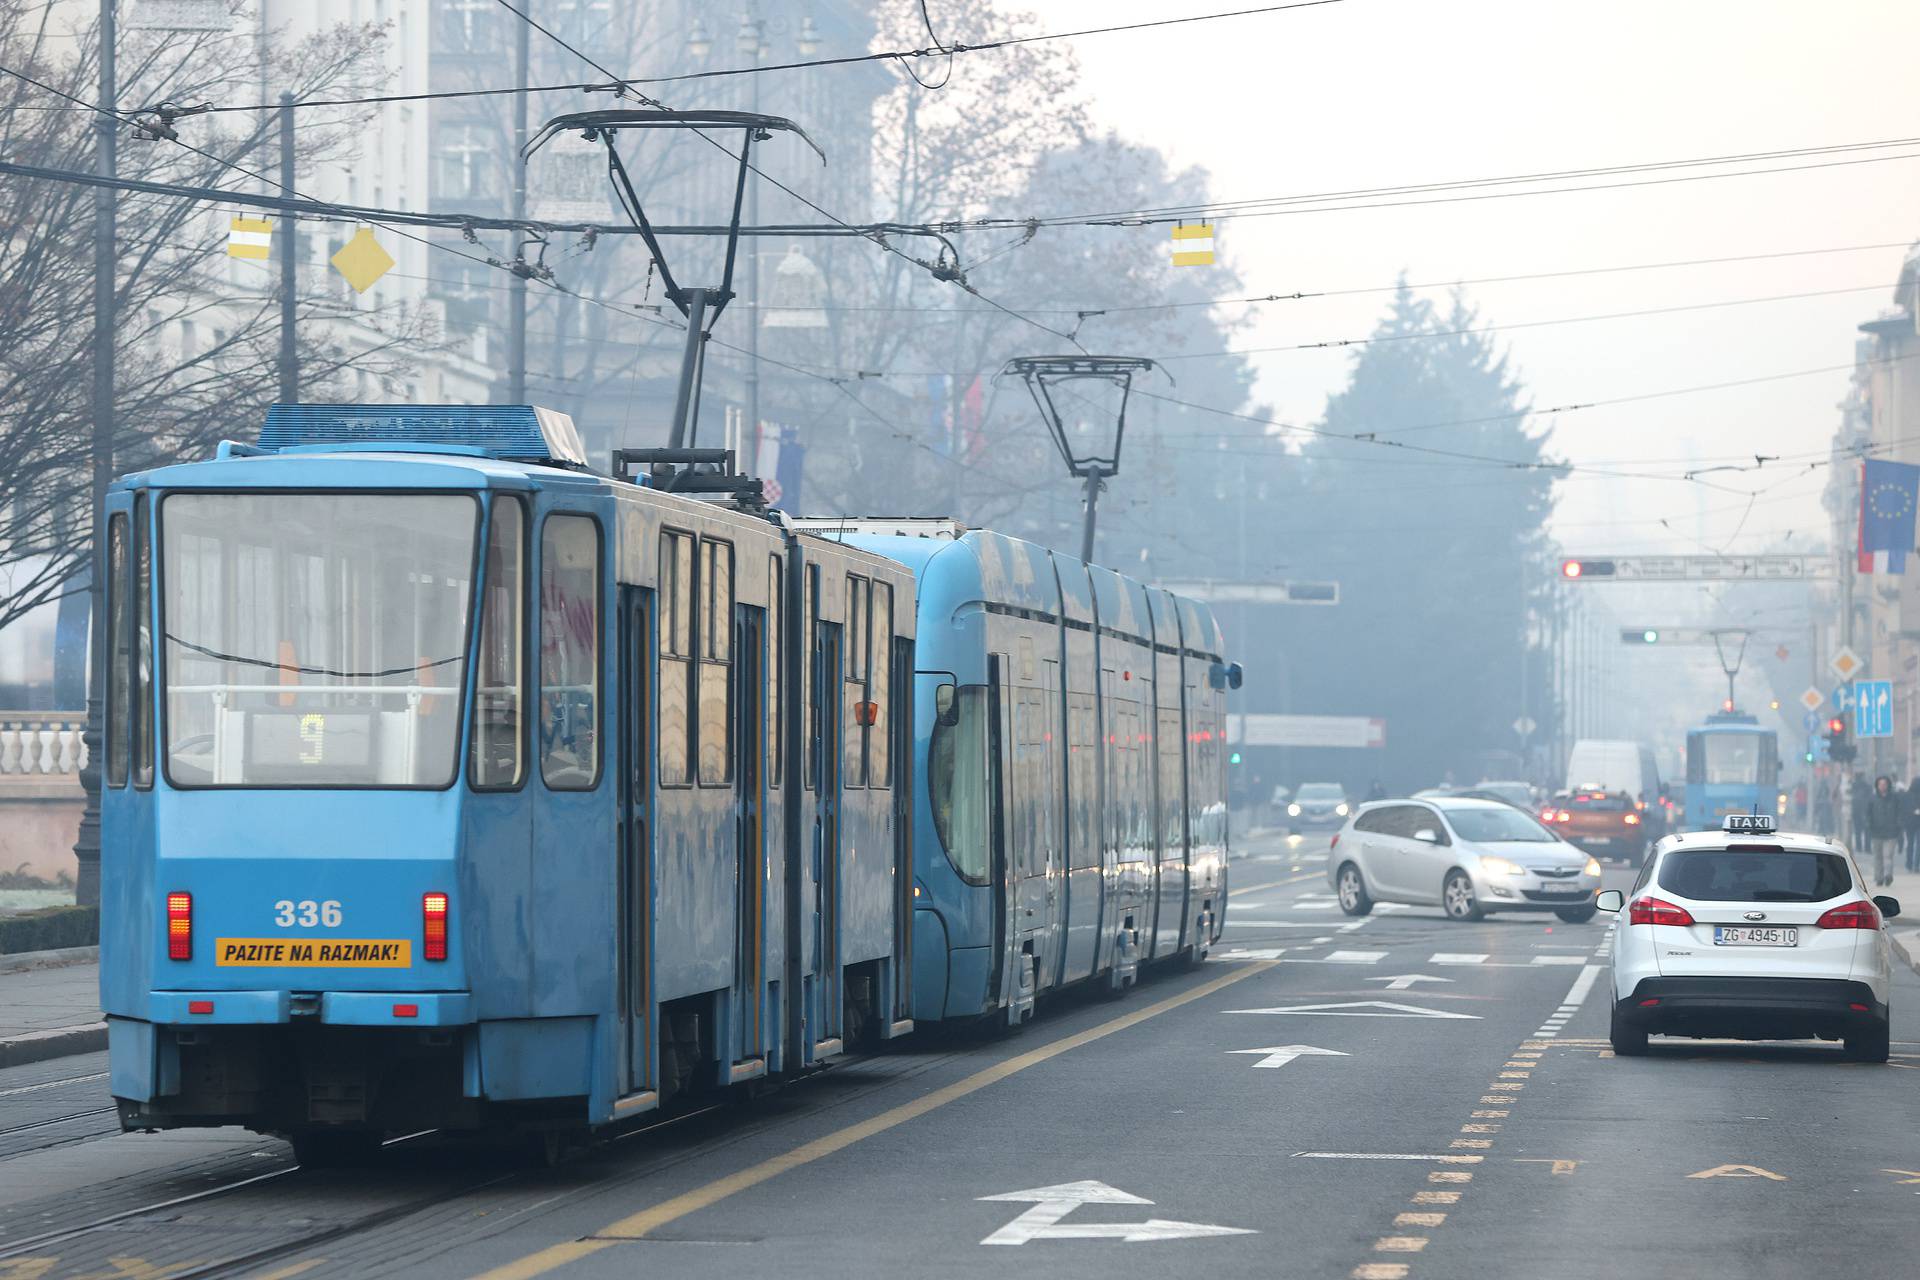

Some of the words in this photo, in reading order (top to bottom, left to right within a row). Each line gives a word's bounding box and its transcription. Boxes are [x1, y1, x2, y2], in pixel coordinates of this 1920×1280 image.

[300, 713, 324, 764] 9
[1731, 817, 1768, 828] TAXI
[274, 900, 343, 928] 336
[1723, 928, 1739, 941] ZG
[224, 944, 285, 962] PAZITE
[289, 945, 313, 961] NA
[319, 944, 400, 961] RAZMAK!
